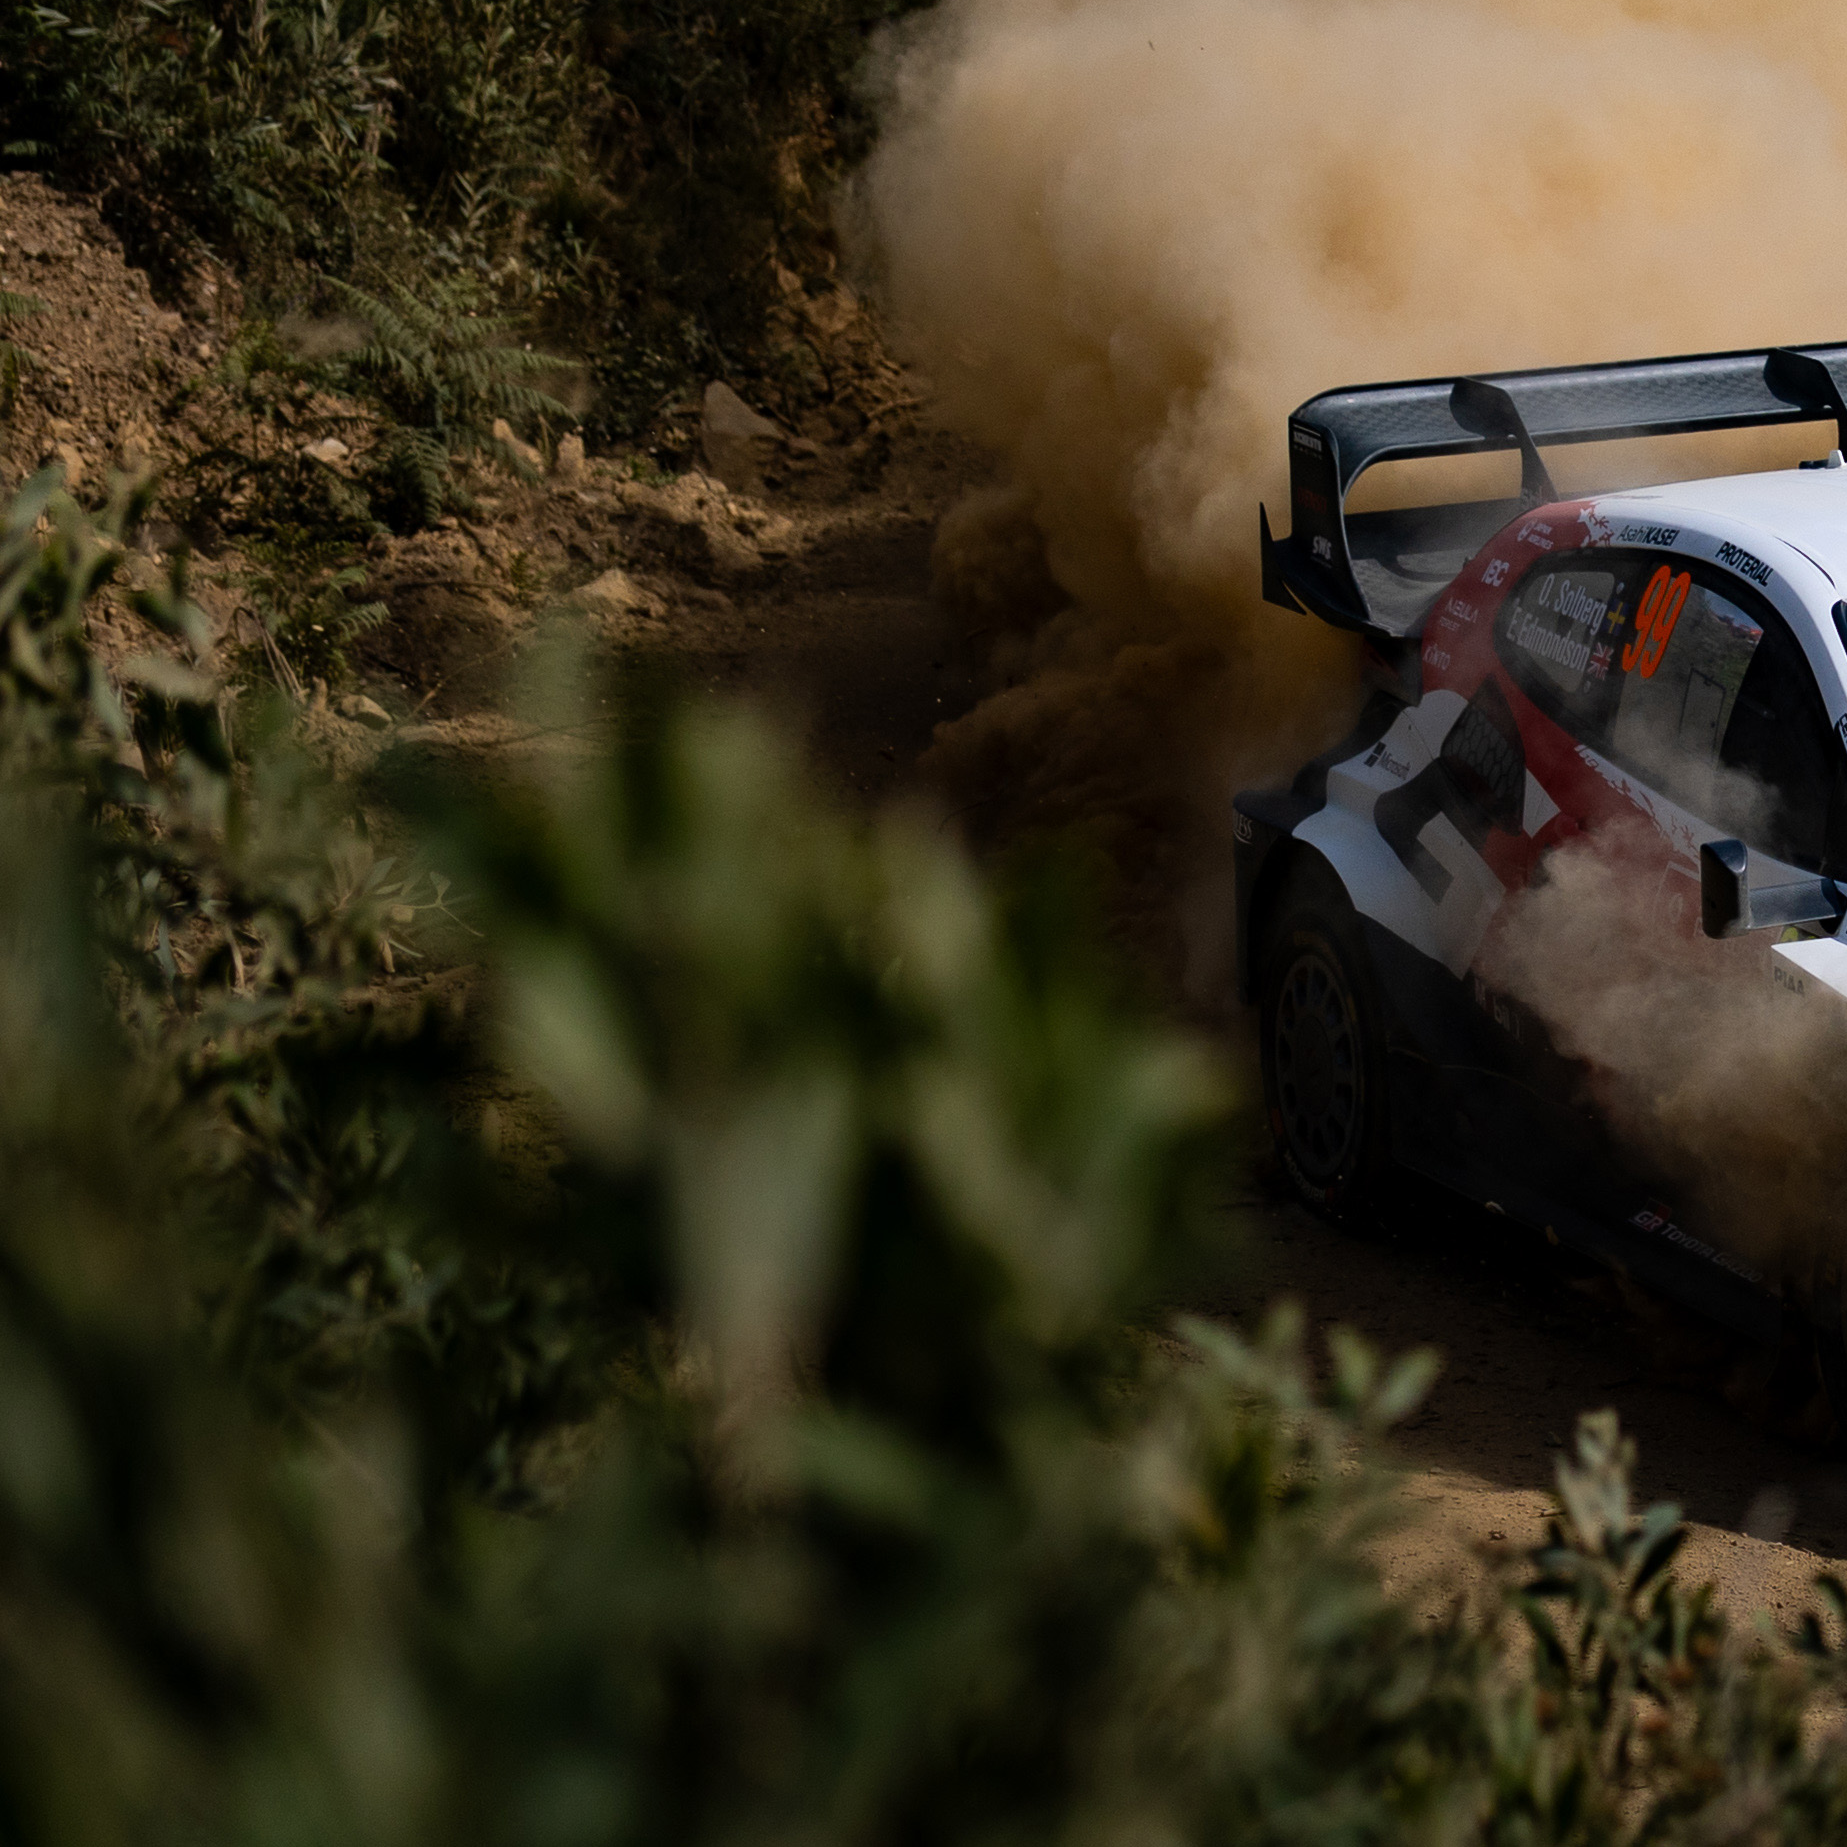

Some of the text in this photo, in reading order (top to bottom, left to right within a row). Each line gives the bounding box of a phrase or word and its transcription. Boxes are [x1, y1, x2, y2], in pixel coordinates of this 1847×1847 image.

[1715, 541, 1774, 586] PROTERIAL
[1554, 579, 1607, 636] Solberg
[1622, 565, 1691, 678] 99
[1633, 1210, 1664, 1231] GR
[1660, 1223, 1714, 1258] TOYOTA
